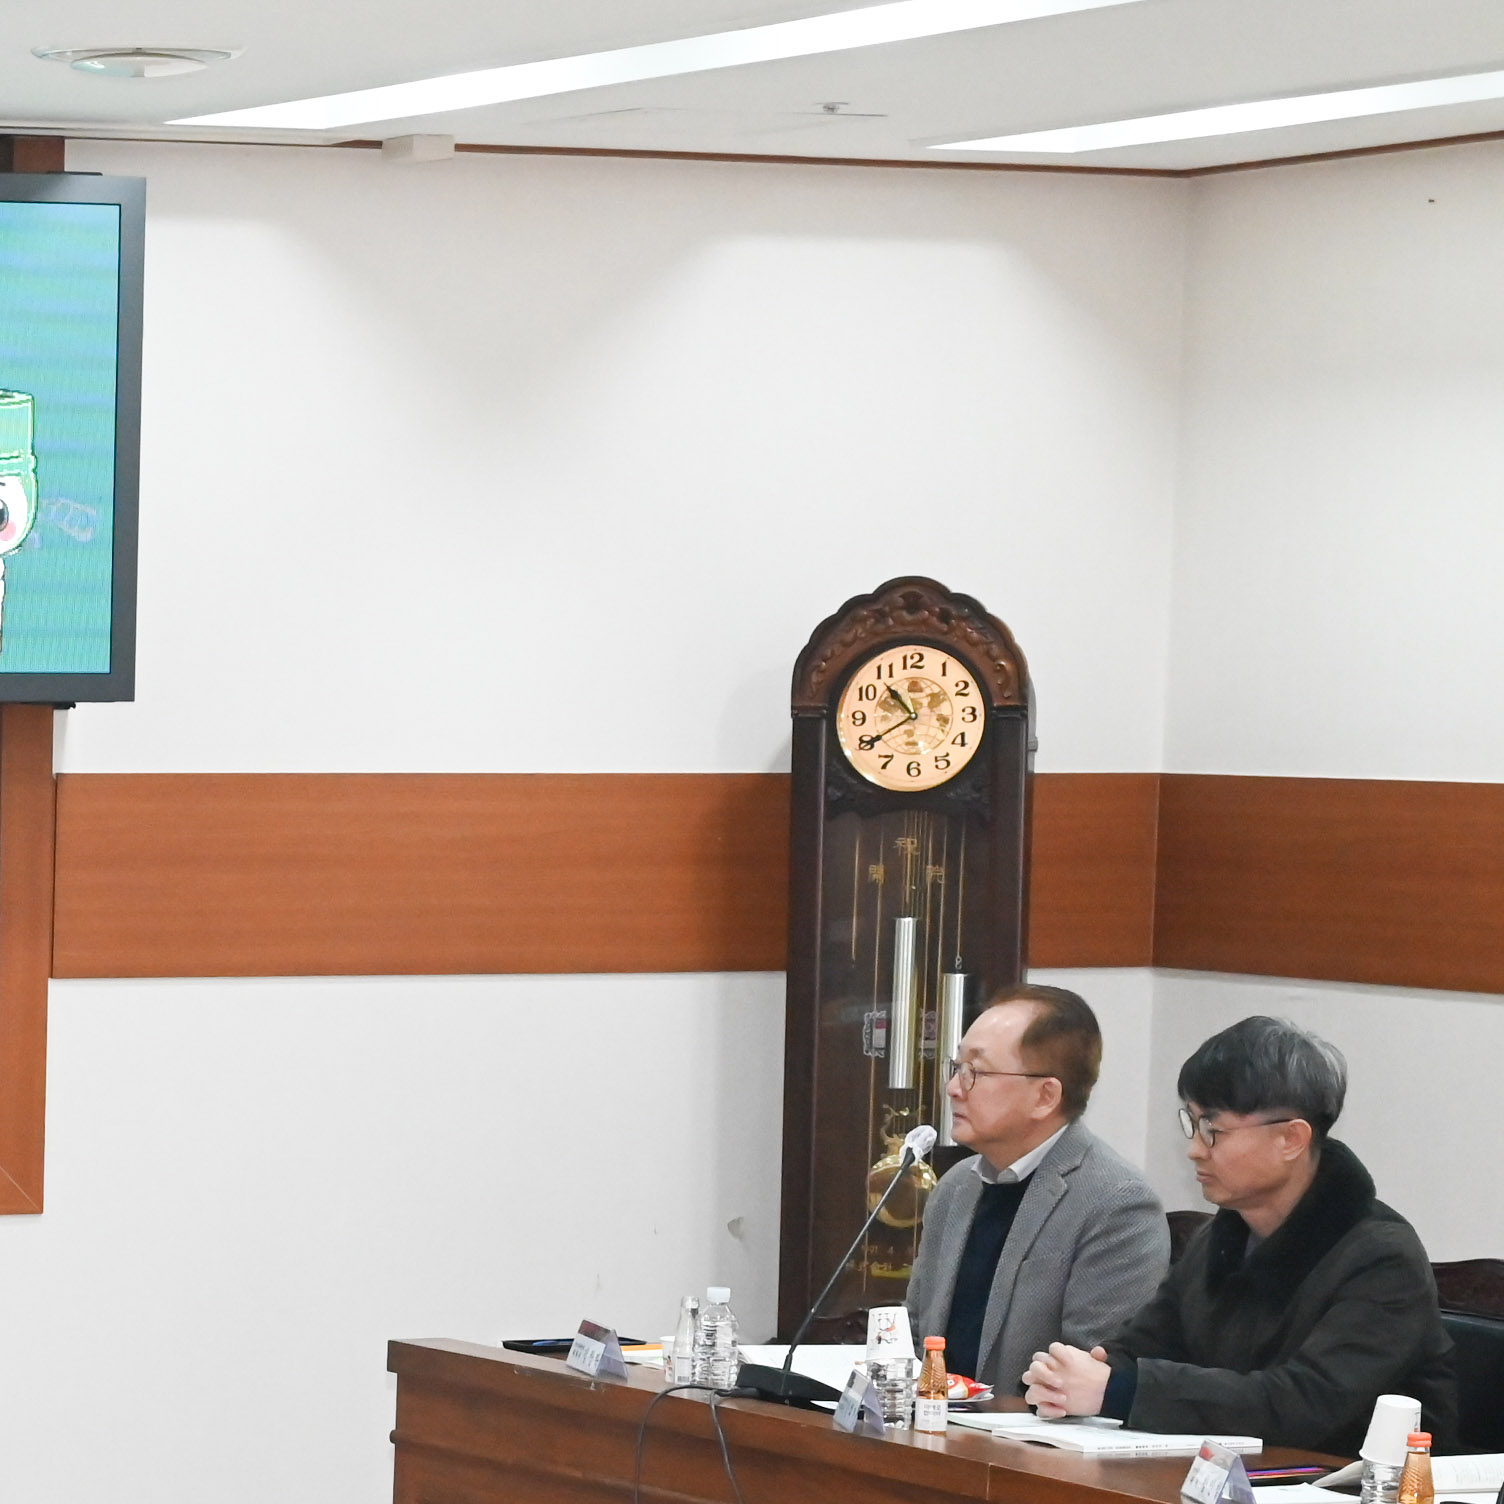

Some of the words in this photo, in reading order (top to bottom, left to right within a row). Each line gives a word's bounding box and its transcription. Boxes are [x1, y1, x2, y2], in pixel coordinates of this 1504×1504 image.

[902, 652, 925, 670] 12
[941, 660, 948, 677] 1
[876, 662, 894, 680] 11
[858, 683, 877, 701] 10
[954, 680, 970, 697] 2
[851, 710, 867, 727] 9
[961, 705, 977, 723] 3
[858, 734, 875, 751] 8
[951, 731, 968, 748] 4
[878, 754, 894, 770] 7
[906, 761, 922, 778] 6
[934, 752, 951, 770] 5
